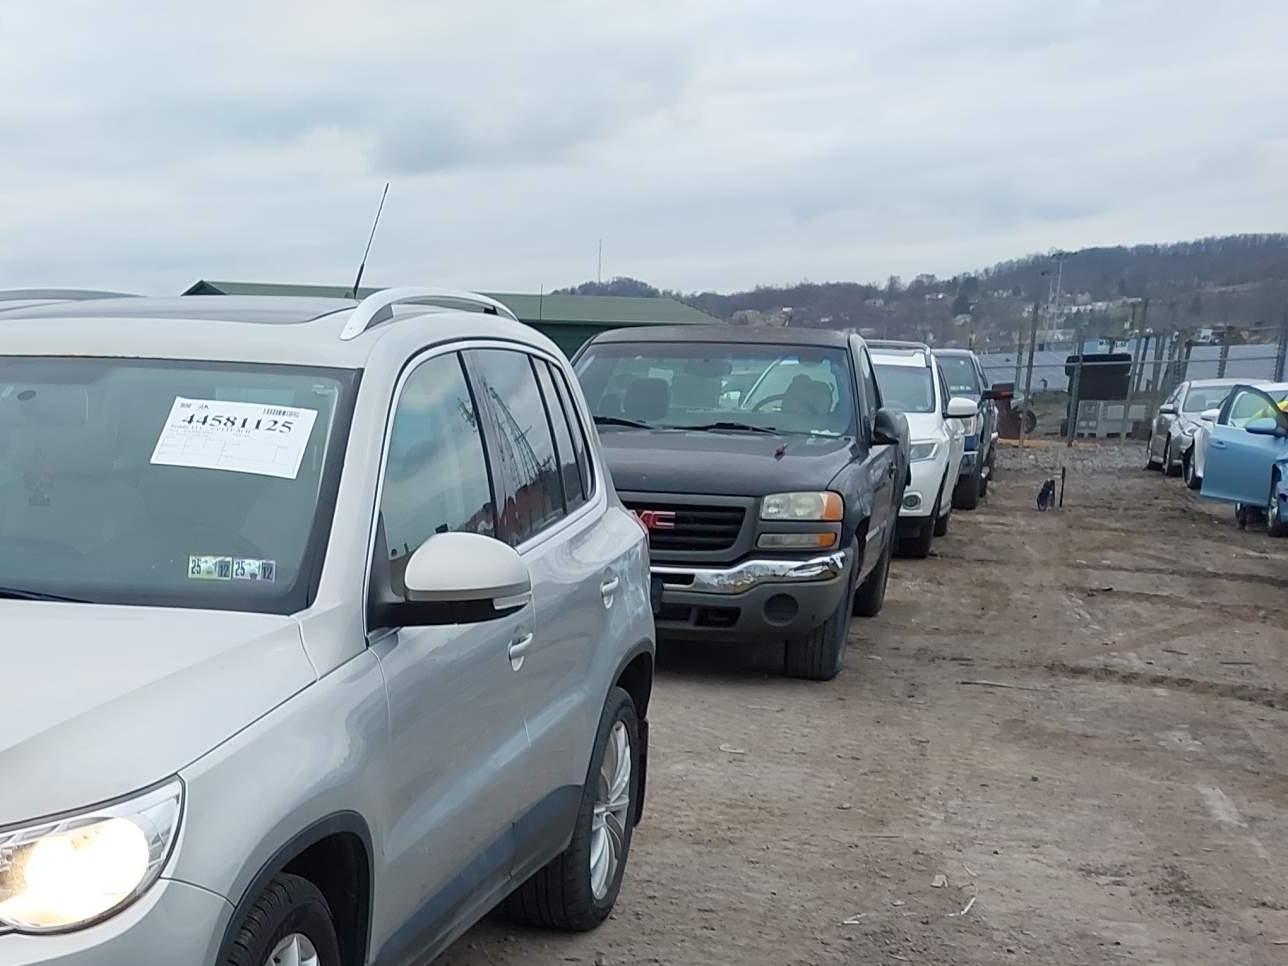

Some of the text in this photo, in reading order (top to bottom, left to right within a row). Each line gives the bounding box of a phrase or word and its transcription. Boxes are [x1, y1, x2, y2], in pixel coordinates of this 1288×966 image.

[182, 413, 294, 434] 44581125
[638, 510, 676, 529] MC
[191, 559, 202, 575] 25
[218, 562, 230, 578] 12
[235, 560, 246, 576] 25
[263, 566, 274, 580] 12
